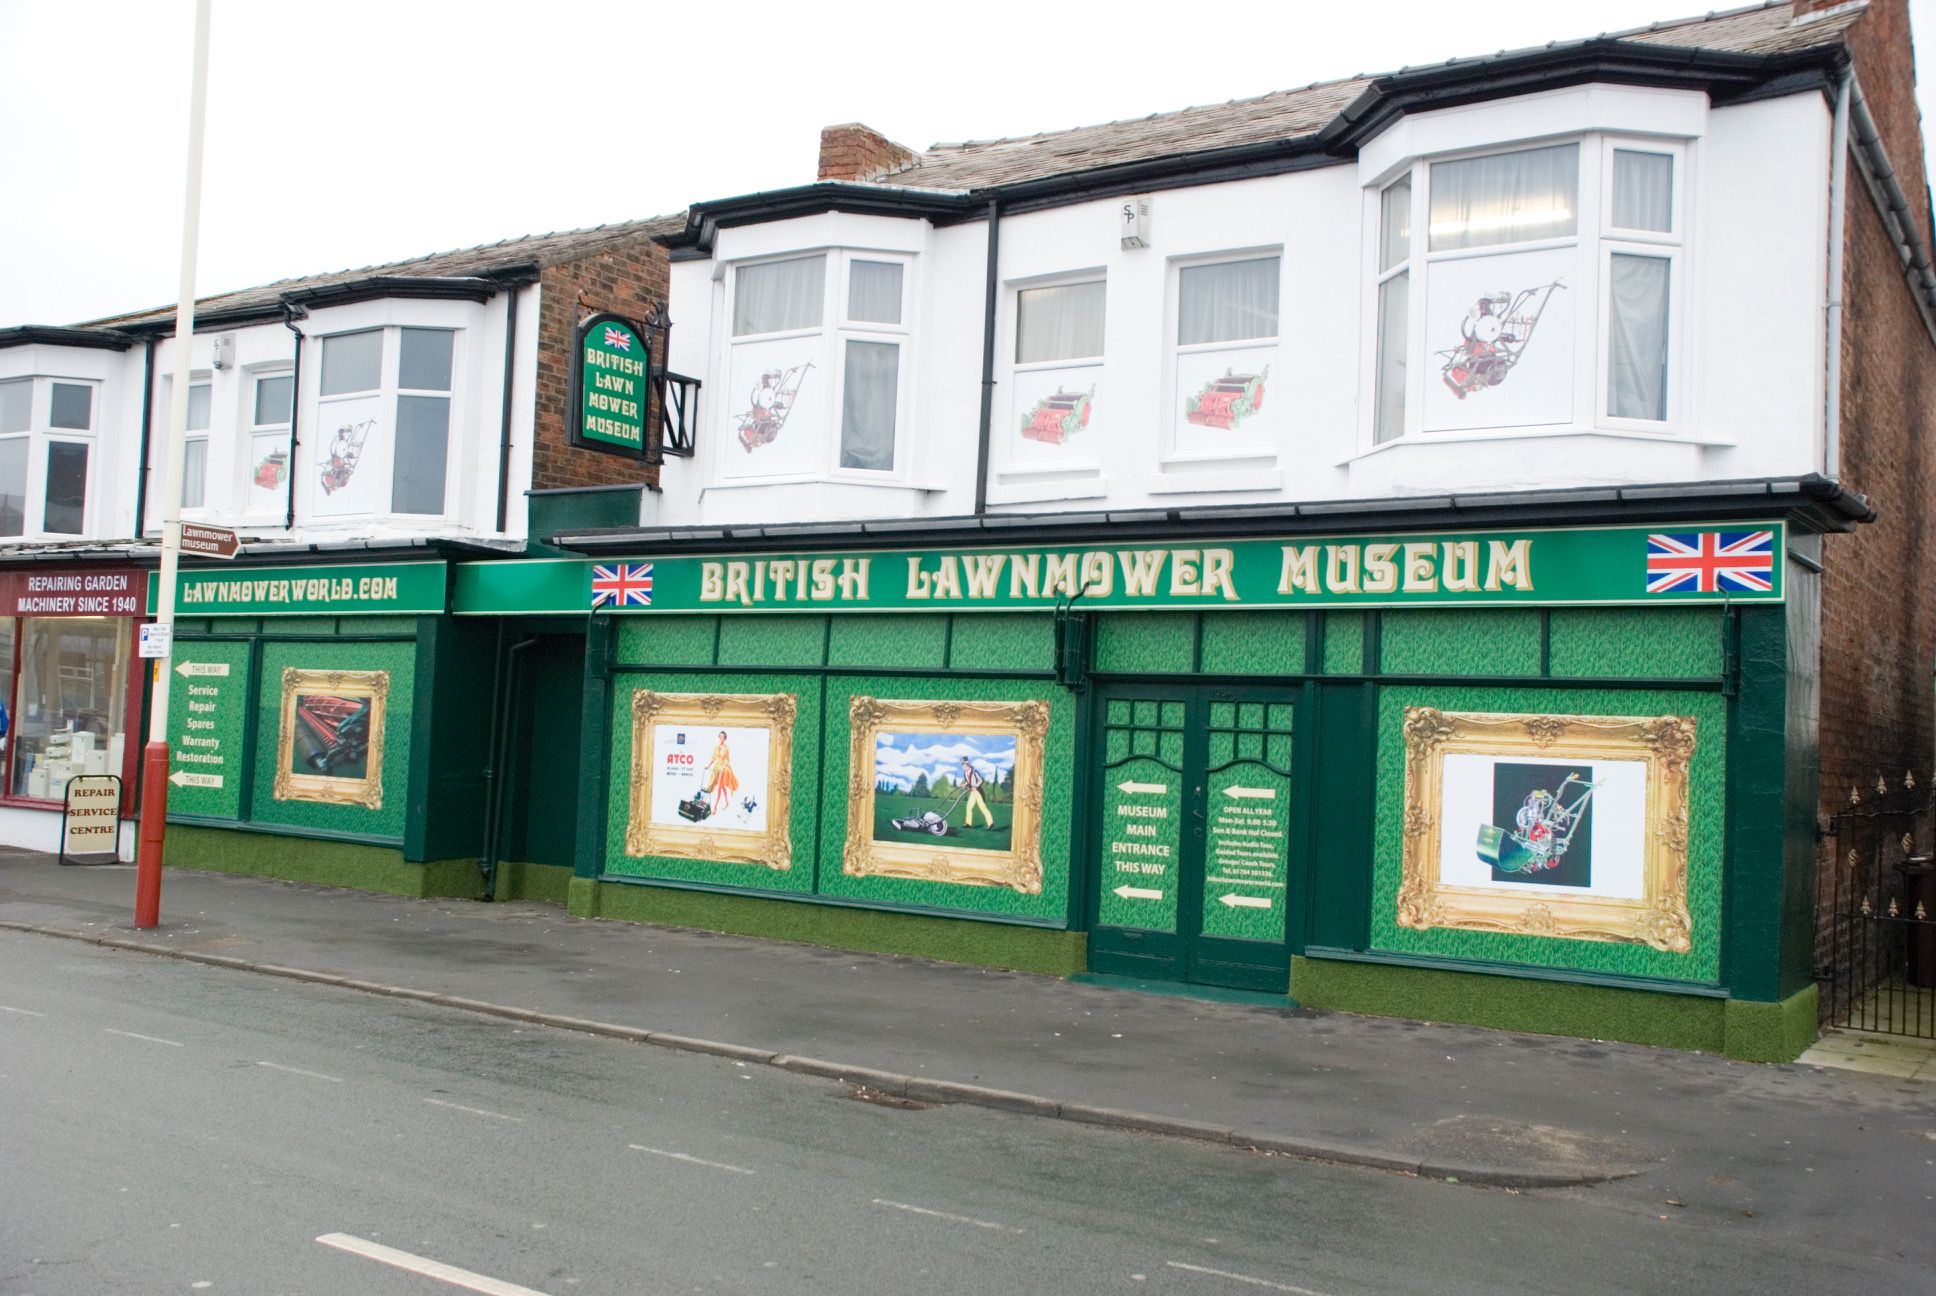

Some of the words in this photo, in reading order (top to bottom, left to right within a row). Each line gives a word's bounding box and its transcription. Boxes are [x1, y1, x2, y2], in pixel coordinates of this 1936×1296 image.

[587, 347, 644, 377] BRITISH
[595, 371, 634, 396] LAWN
[589, 391, 638, 419] MOWER
[586, 414, 640, 441] MUSEUM
[183, 524, 233, 542] Lawnmower
[182, 538, 219, 551] museum
[699, 559, 872, 606] BRITISH
[905, 549, 1241, 601] LAWNMOWER
[1277, 540, 1535, 595] MUSEUM
[28, 576, 82, 591] REPAIRING
[84, 575, 128, 590] GARDEN
[183, 577, 398, 604] LAWNMOWERWORLD.COM
[17, 597, 76, 612] MACHINERY
[78, 596, 109, 612] SINCE
[112, 596, 136, 612] 1940
[191, 665, 207, 674] THIS
[207, 665, 222, 674] WAY
[188, 684, 219, 696] Service
[189, 700, 216, 714] Repair
[187, 717, 215, 730] Spares
[182, 735, 221, 753] Warranty
[176, 750, 224, 764] Restoration
[666, 753, 694, 765] ATCO
[185, 774, 200, 784] THIS
[200, 775, 215, 785] WAY
[74, 788, 115, 797] REPAIR
[69, 808, 117, 816] SERVICE
[1117, 805, 1167, 818] MUSEUM
[1223, 806, 1241, 814] OPEN
[1242, 807, 1255, 815] ALL
[70, 825, 115, 834] CENTRE
[1126, 824, 1156, 836] MAIN
[1260, 829, 1282, 838] Closed
[1112, 842, 1170, 857] ENTRANCE
[1115, 860, 1140, 873] THIS
[1141, 862, 1166, 875] WAY
